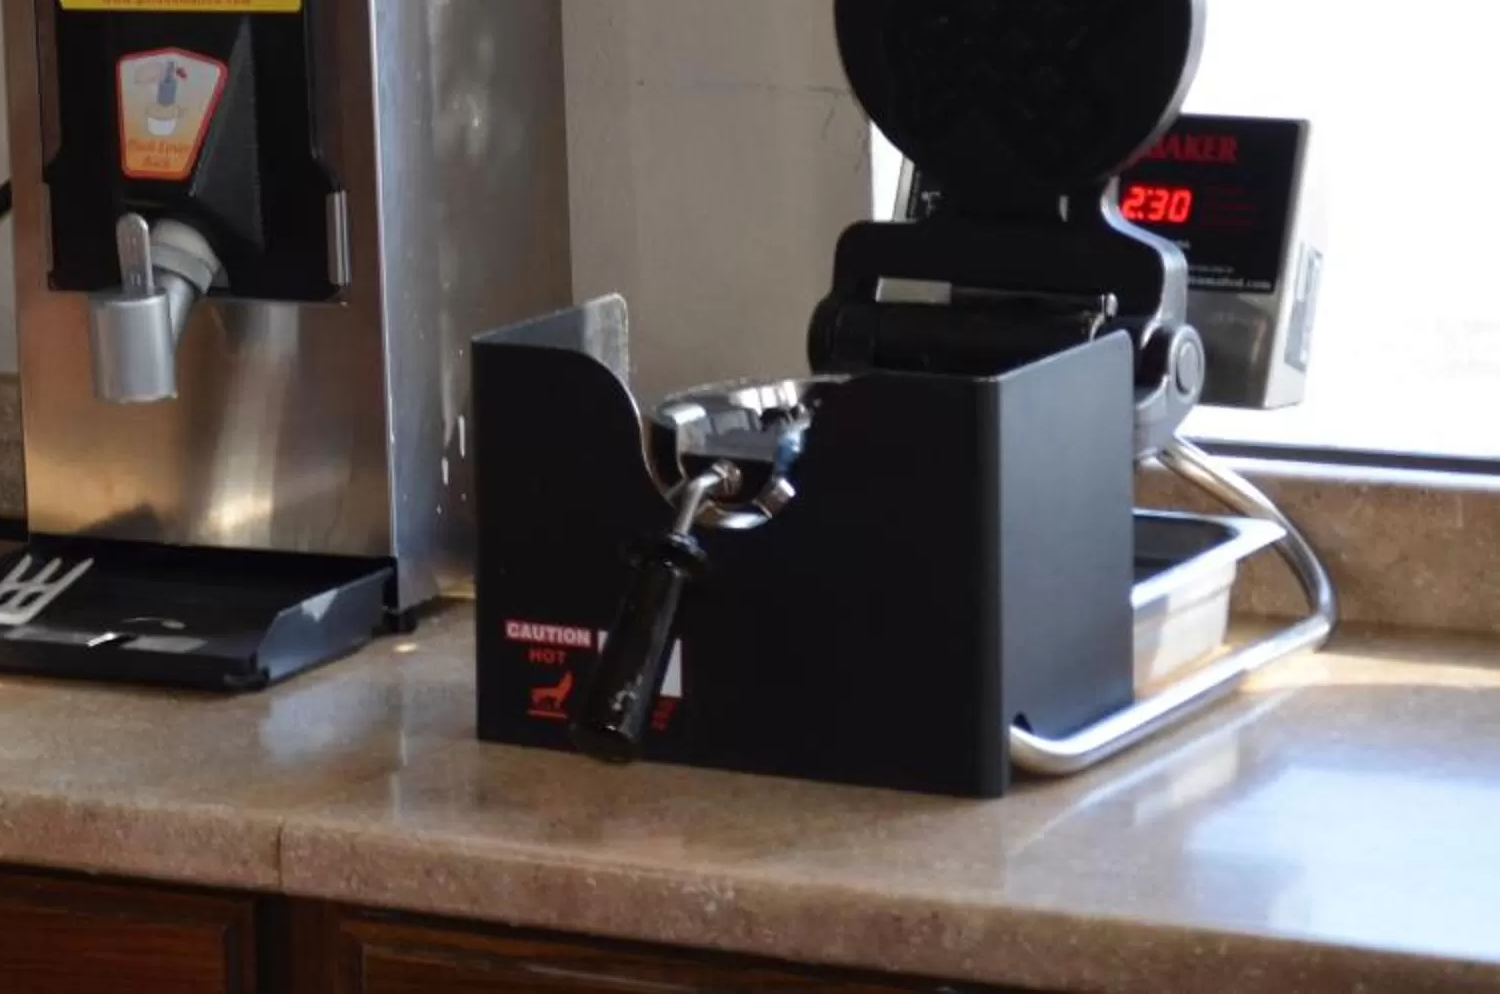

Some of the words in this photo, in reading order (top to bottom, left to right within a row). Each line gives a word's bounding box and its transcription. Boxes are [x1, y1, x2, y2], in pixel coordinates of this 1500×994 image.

[1121, 184, 1194, 223] 2:30
[506, 620, 592, 647] CAUTION
[528, 649, 568, 665] HOT
